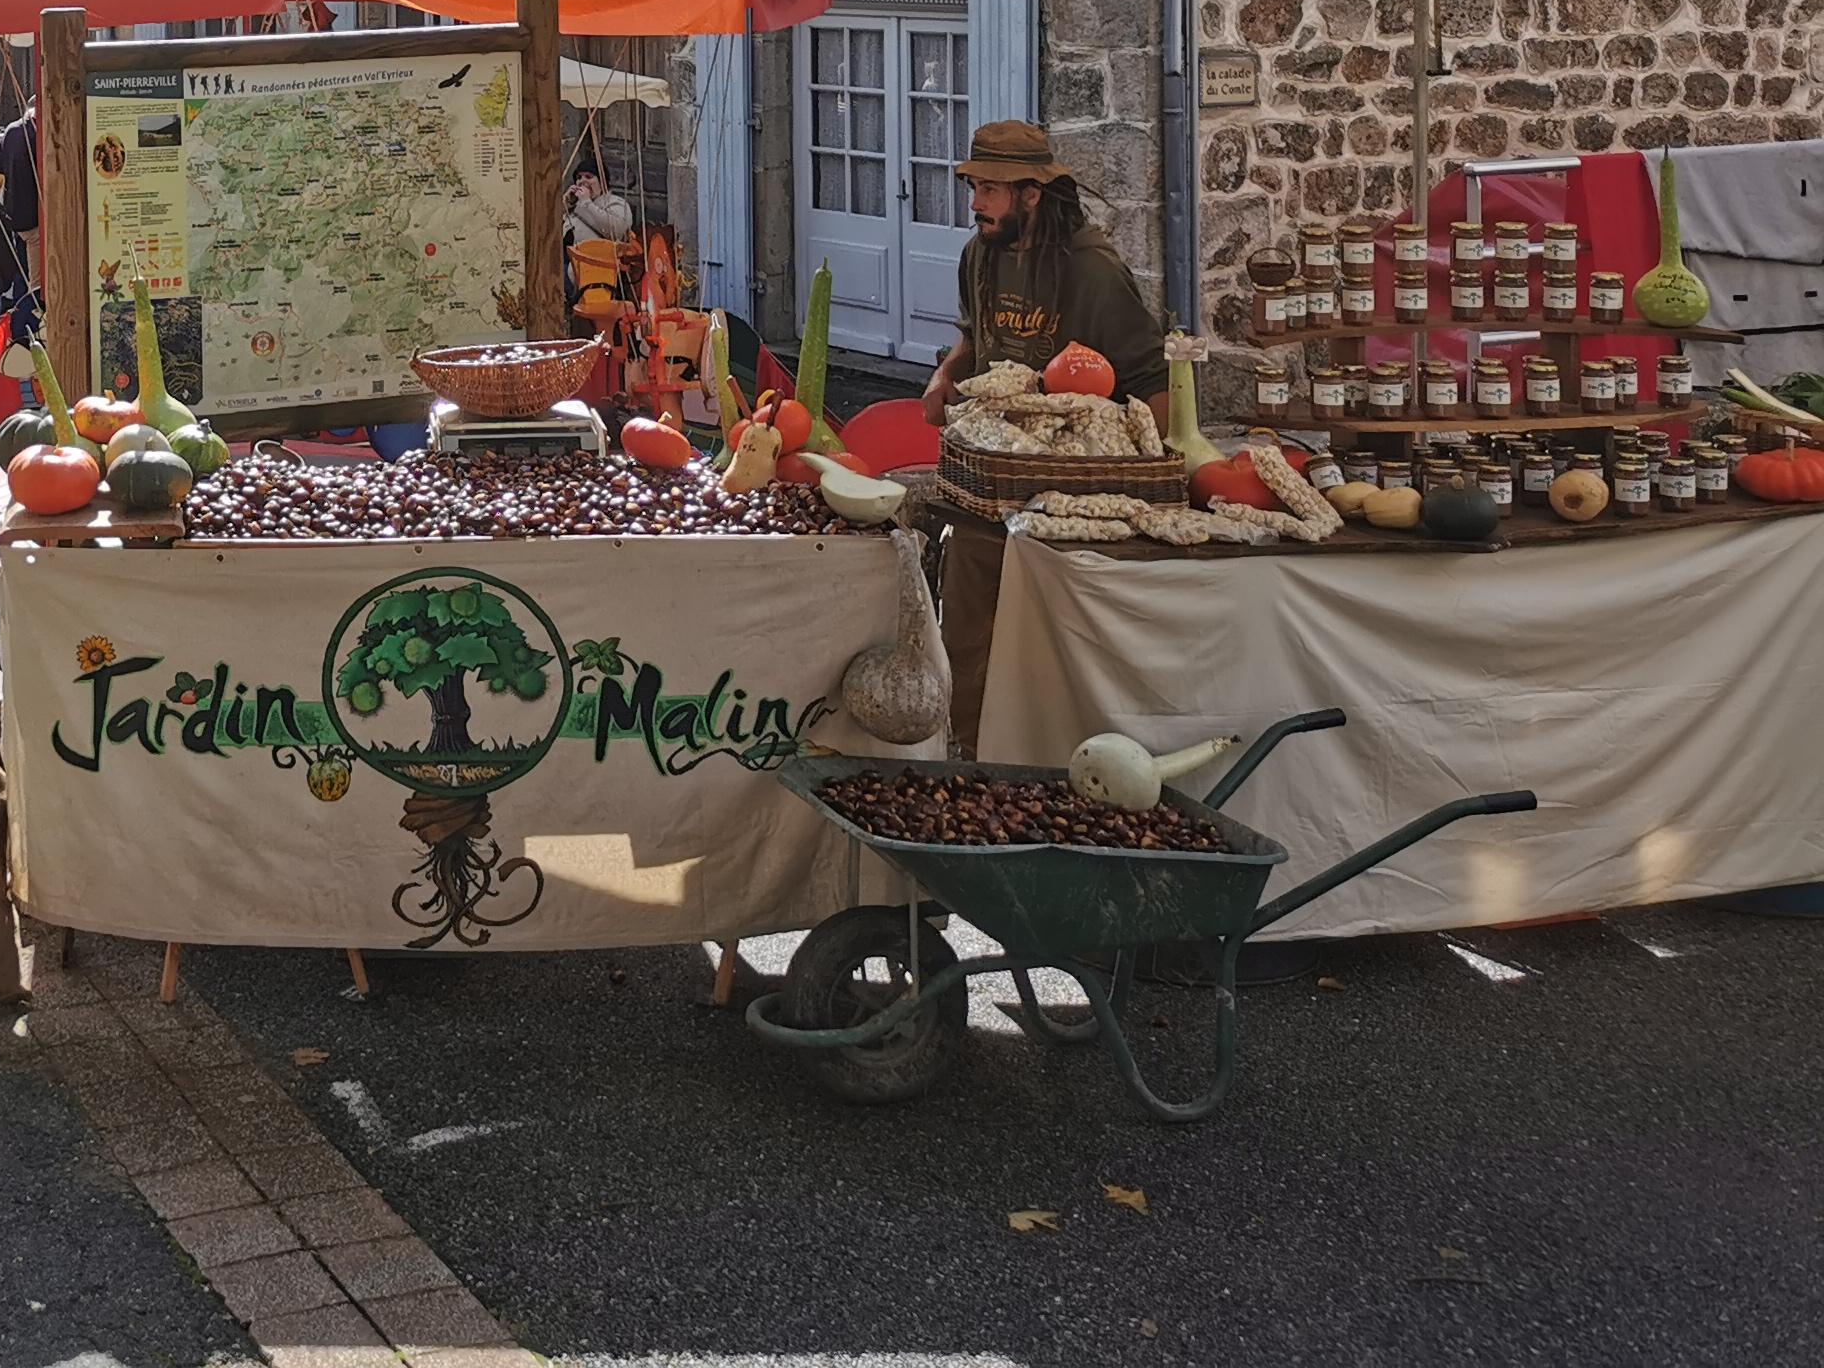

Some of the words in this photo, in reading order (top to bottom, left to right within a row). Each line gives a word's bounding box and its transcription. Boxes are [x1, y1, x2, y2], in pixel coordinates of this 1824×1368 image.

[1218, 68, 1252, 80] calade
[94, 75, 177, 89] SAINT-PIERREVILLE
[251, 81, 306, 93] Randonnées
[307, 75, 351, 91] pédestres
[353, 74, 363, 82] en
[1206, 85, 1218, 95] du
[53, 656, 307, 772] Jardin
[595, 663, 798, 776] Malin
